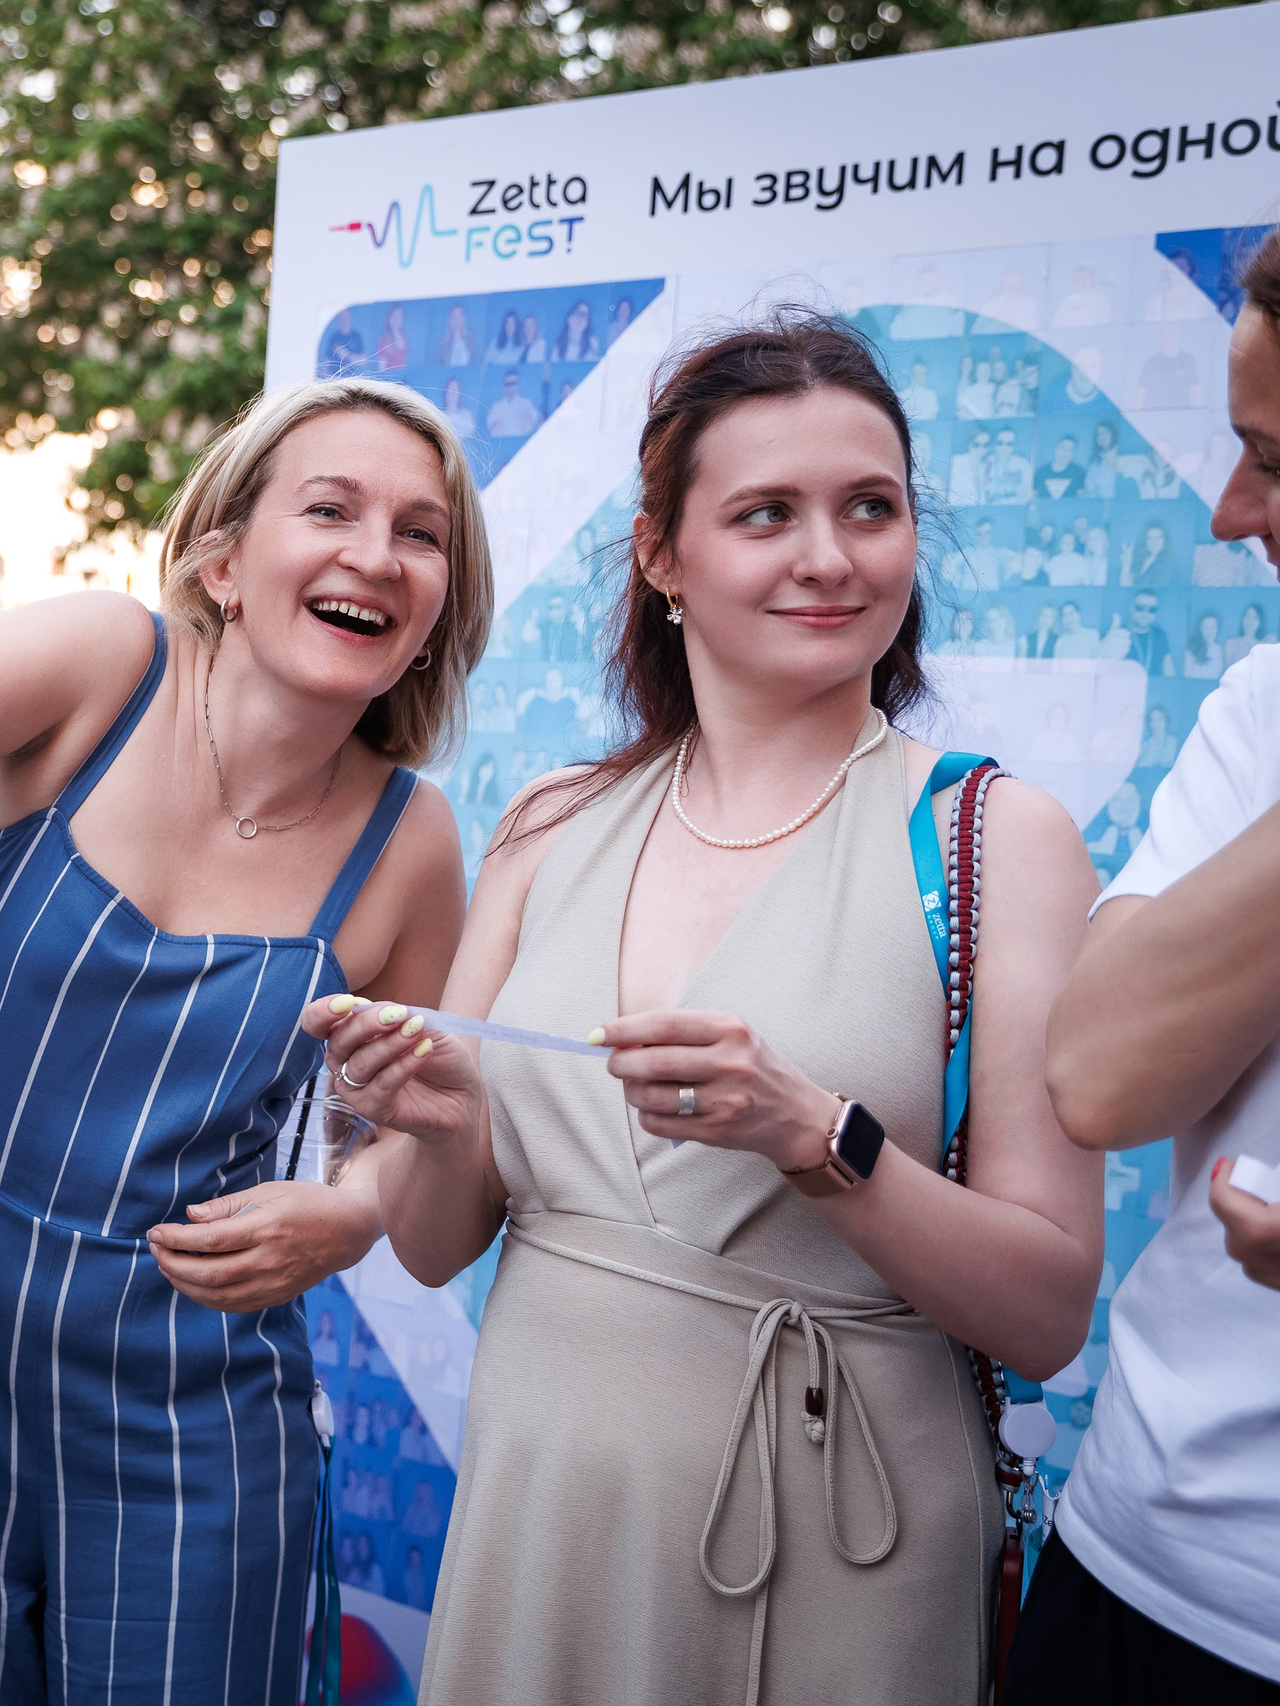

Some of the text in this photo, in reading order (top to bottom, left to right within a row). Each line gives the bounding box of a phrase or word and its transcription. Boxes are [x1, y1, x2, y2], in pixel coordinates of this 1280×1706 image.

[469, 173, 587, 216] Zetta
[648, 171, 734, 218] Мы
[751, 149, 967, 212] звучим
[988, 138, 1066, 183] на
[932, 912, 947, 938] zetta
